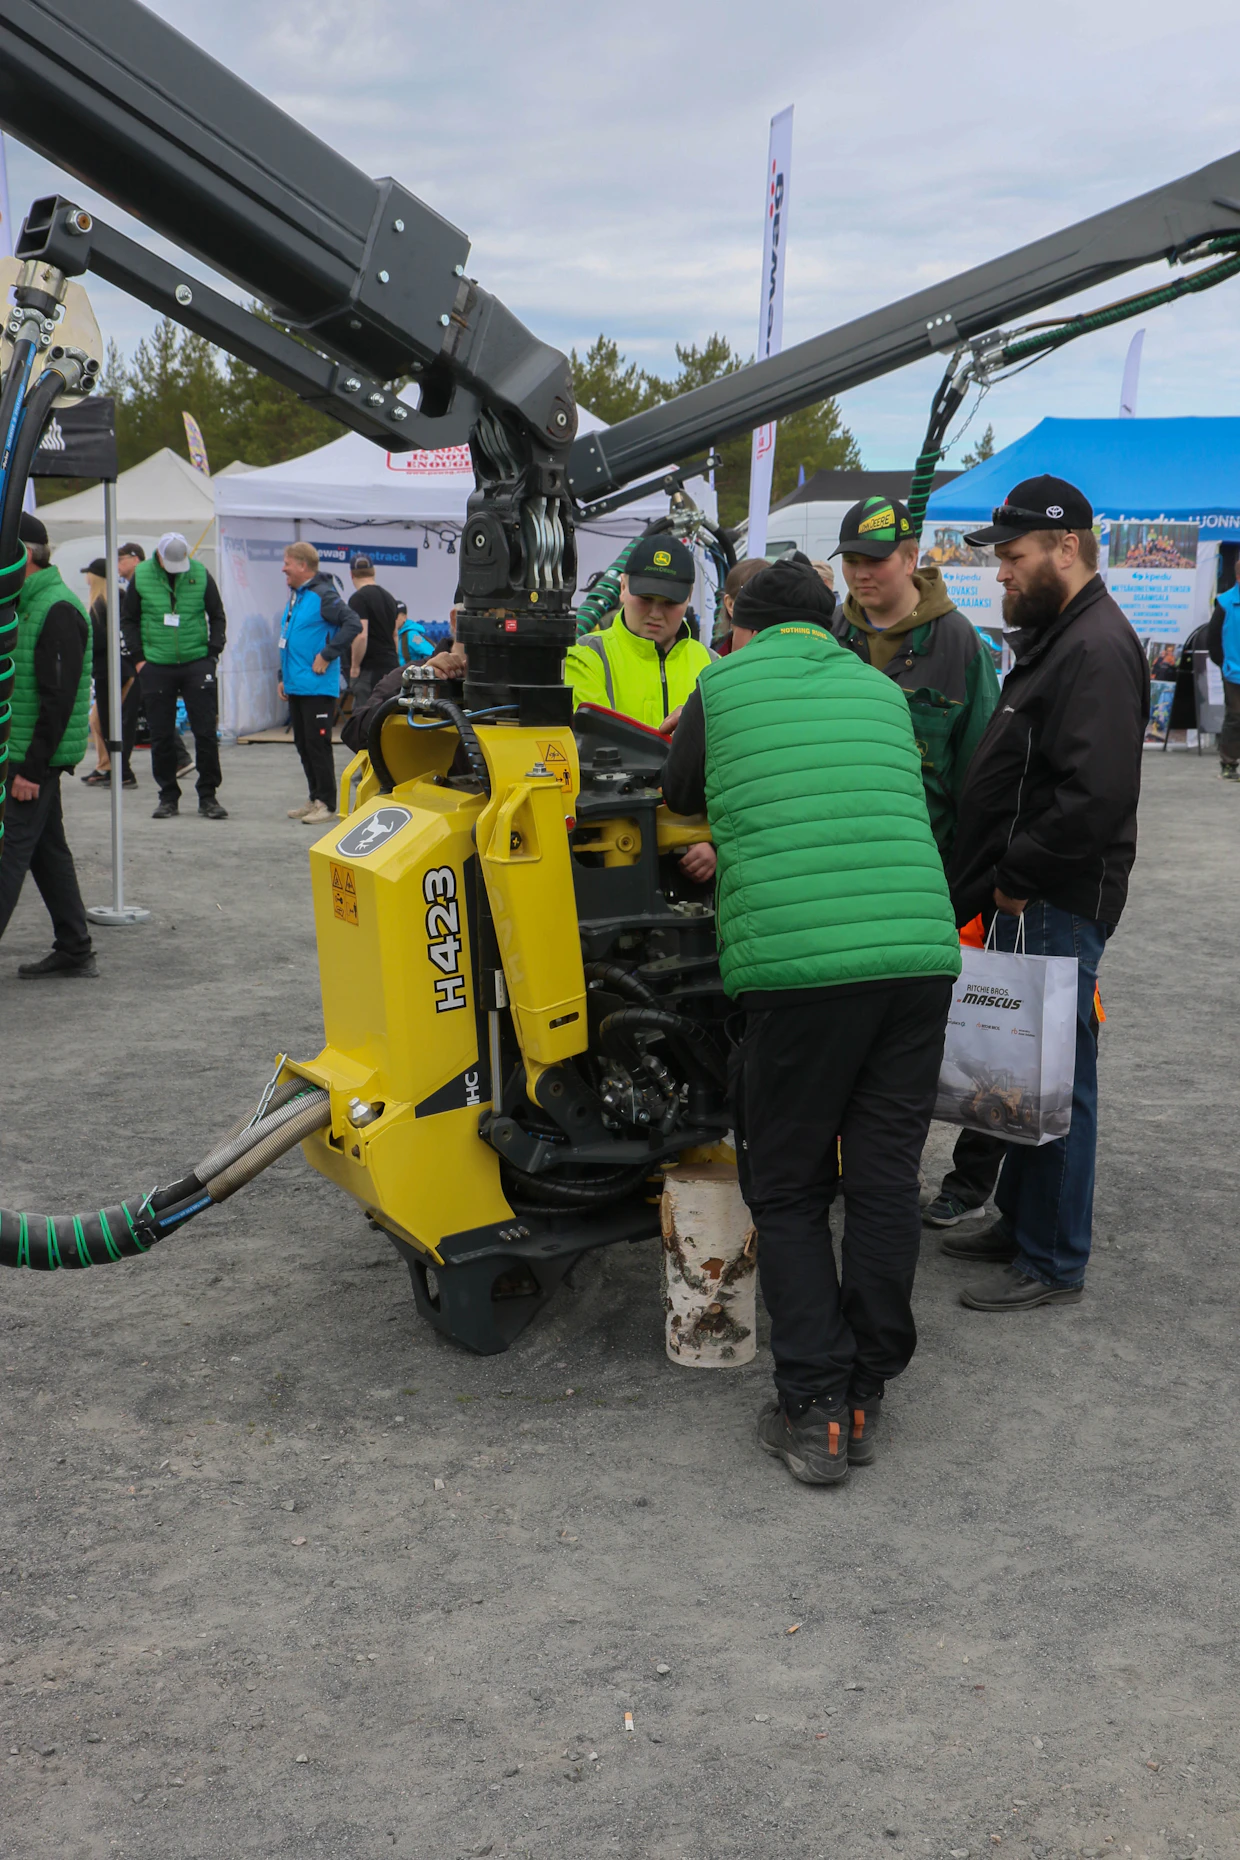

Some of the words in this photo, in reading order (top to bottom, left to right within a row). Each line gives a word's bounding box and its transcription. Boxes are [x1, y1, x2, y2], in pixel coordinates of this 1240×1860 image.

[870, 513, 892, 529] DEERE
[317, 548, 346, 560] ewag
[350, 549, 408, 562] bletrack
[780, 627, 811, 635] NOTHING
[422, 865, 467, 1013] H423
[967, 984, 990, 994] RITCHIE
[962, 993, 1022, 1010] MASCUS
[464, 1071, 480, 1106] IHC
